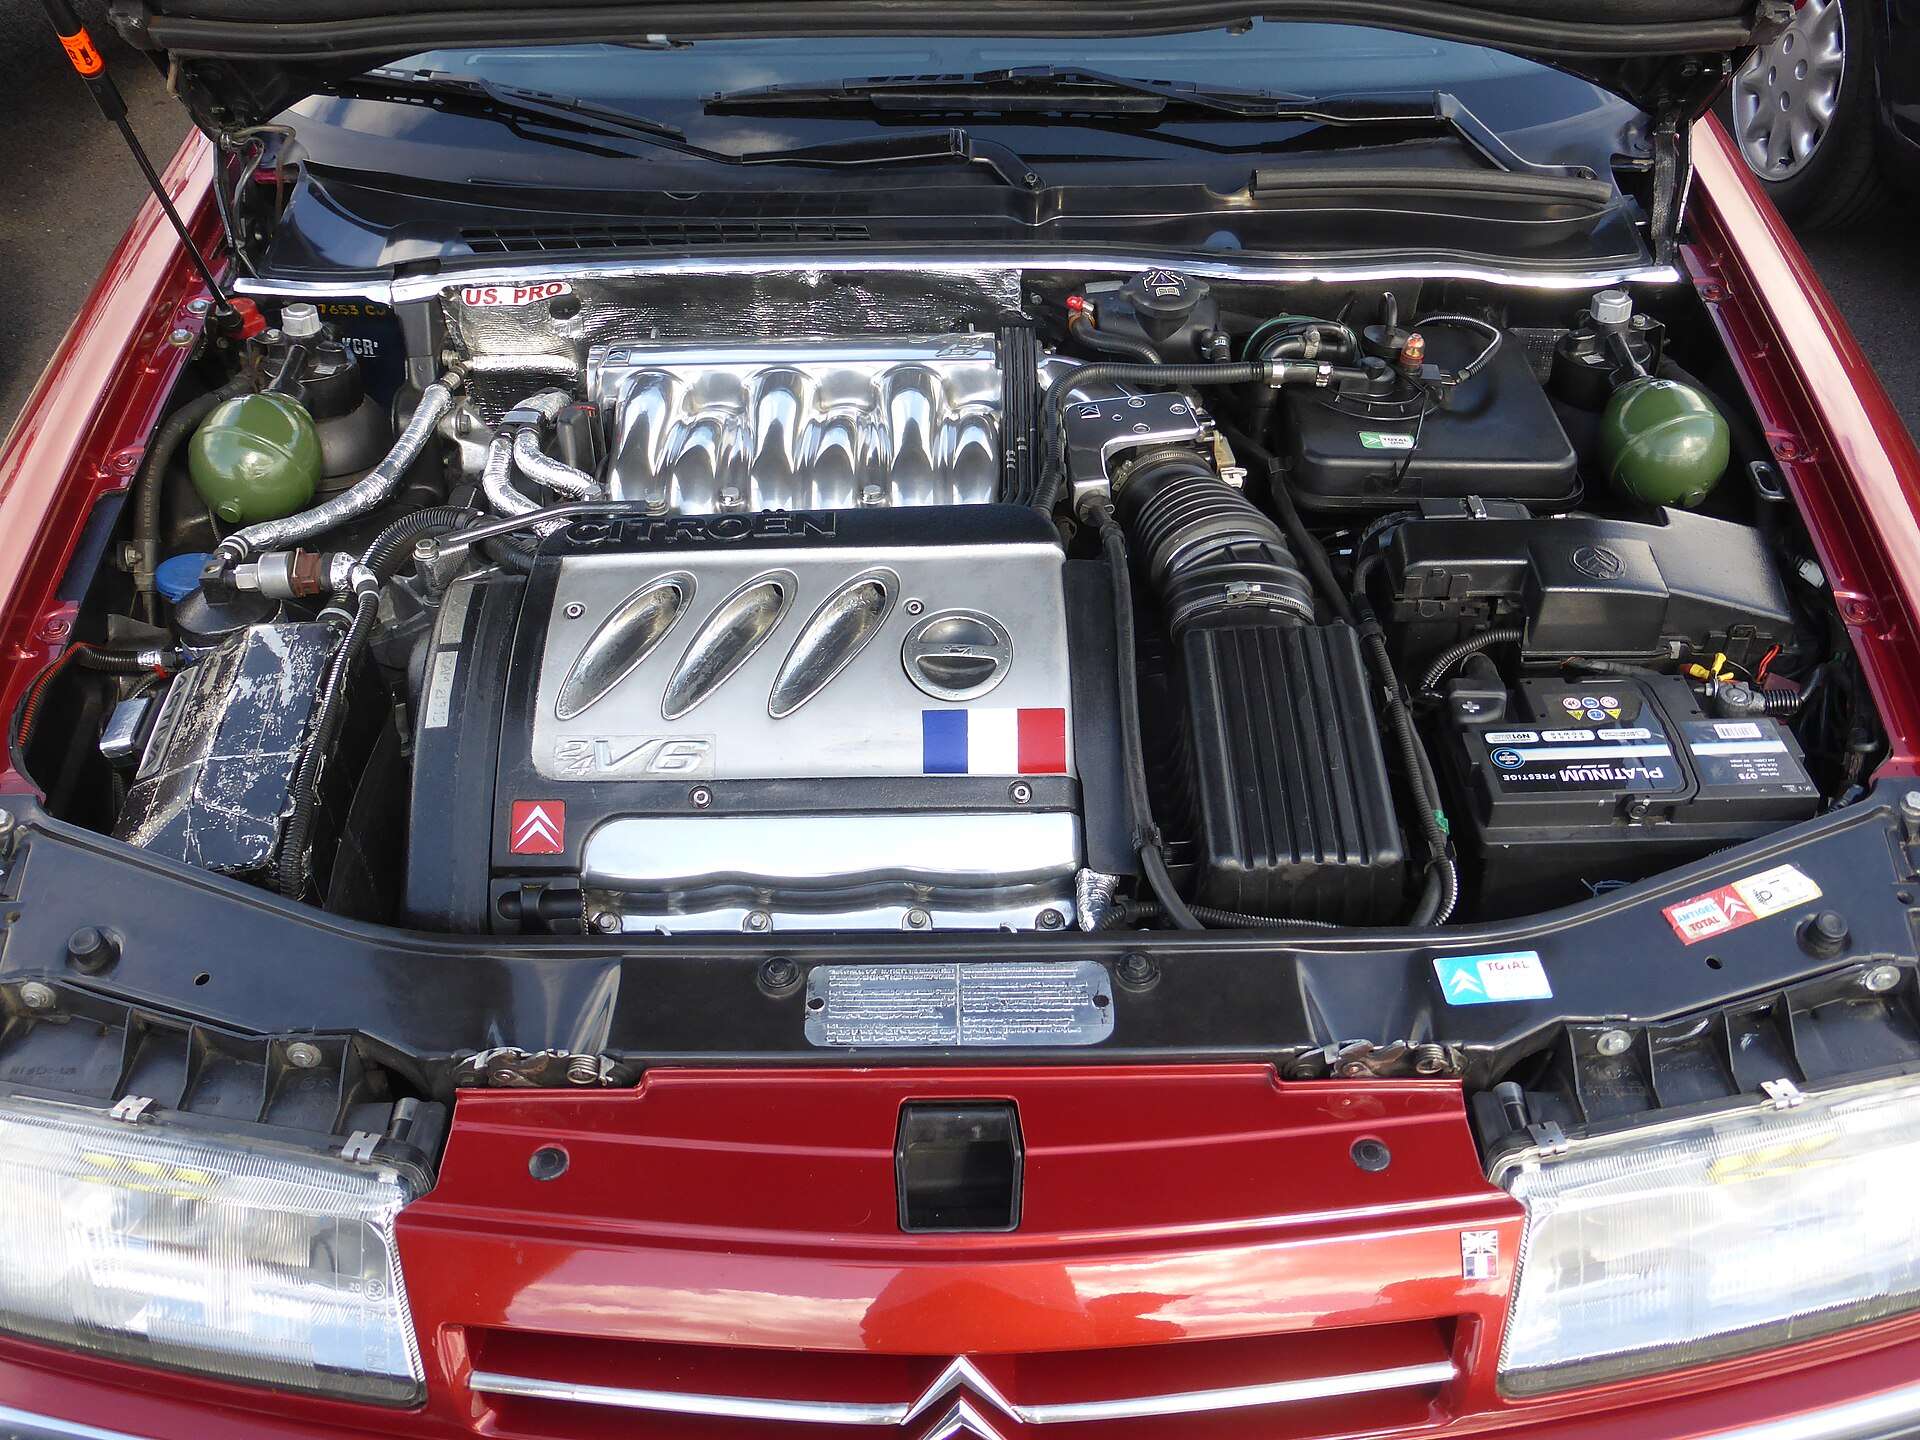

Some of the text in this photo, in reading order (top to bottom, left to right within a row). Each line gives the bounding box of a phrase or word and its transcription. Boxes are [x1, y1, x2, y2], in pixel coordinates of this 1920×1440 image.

[513, 283, 563, 304] PRO
[565, 508, 837, 544] CITROËN
[593, 738, 710, 774] V6
[1502, 766, 1665, 782] PLATINUM PRESTIGE
[1676, 903, 1717, 923] ANTIGEL
[1688, 916, 1721, 932] TOTAL
